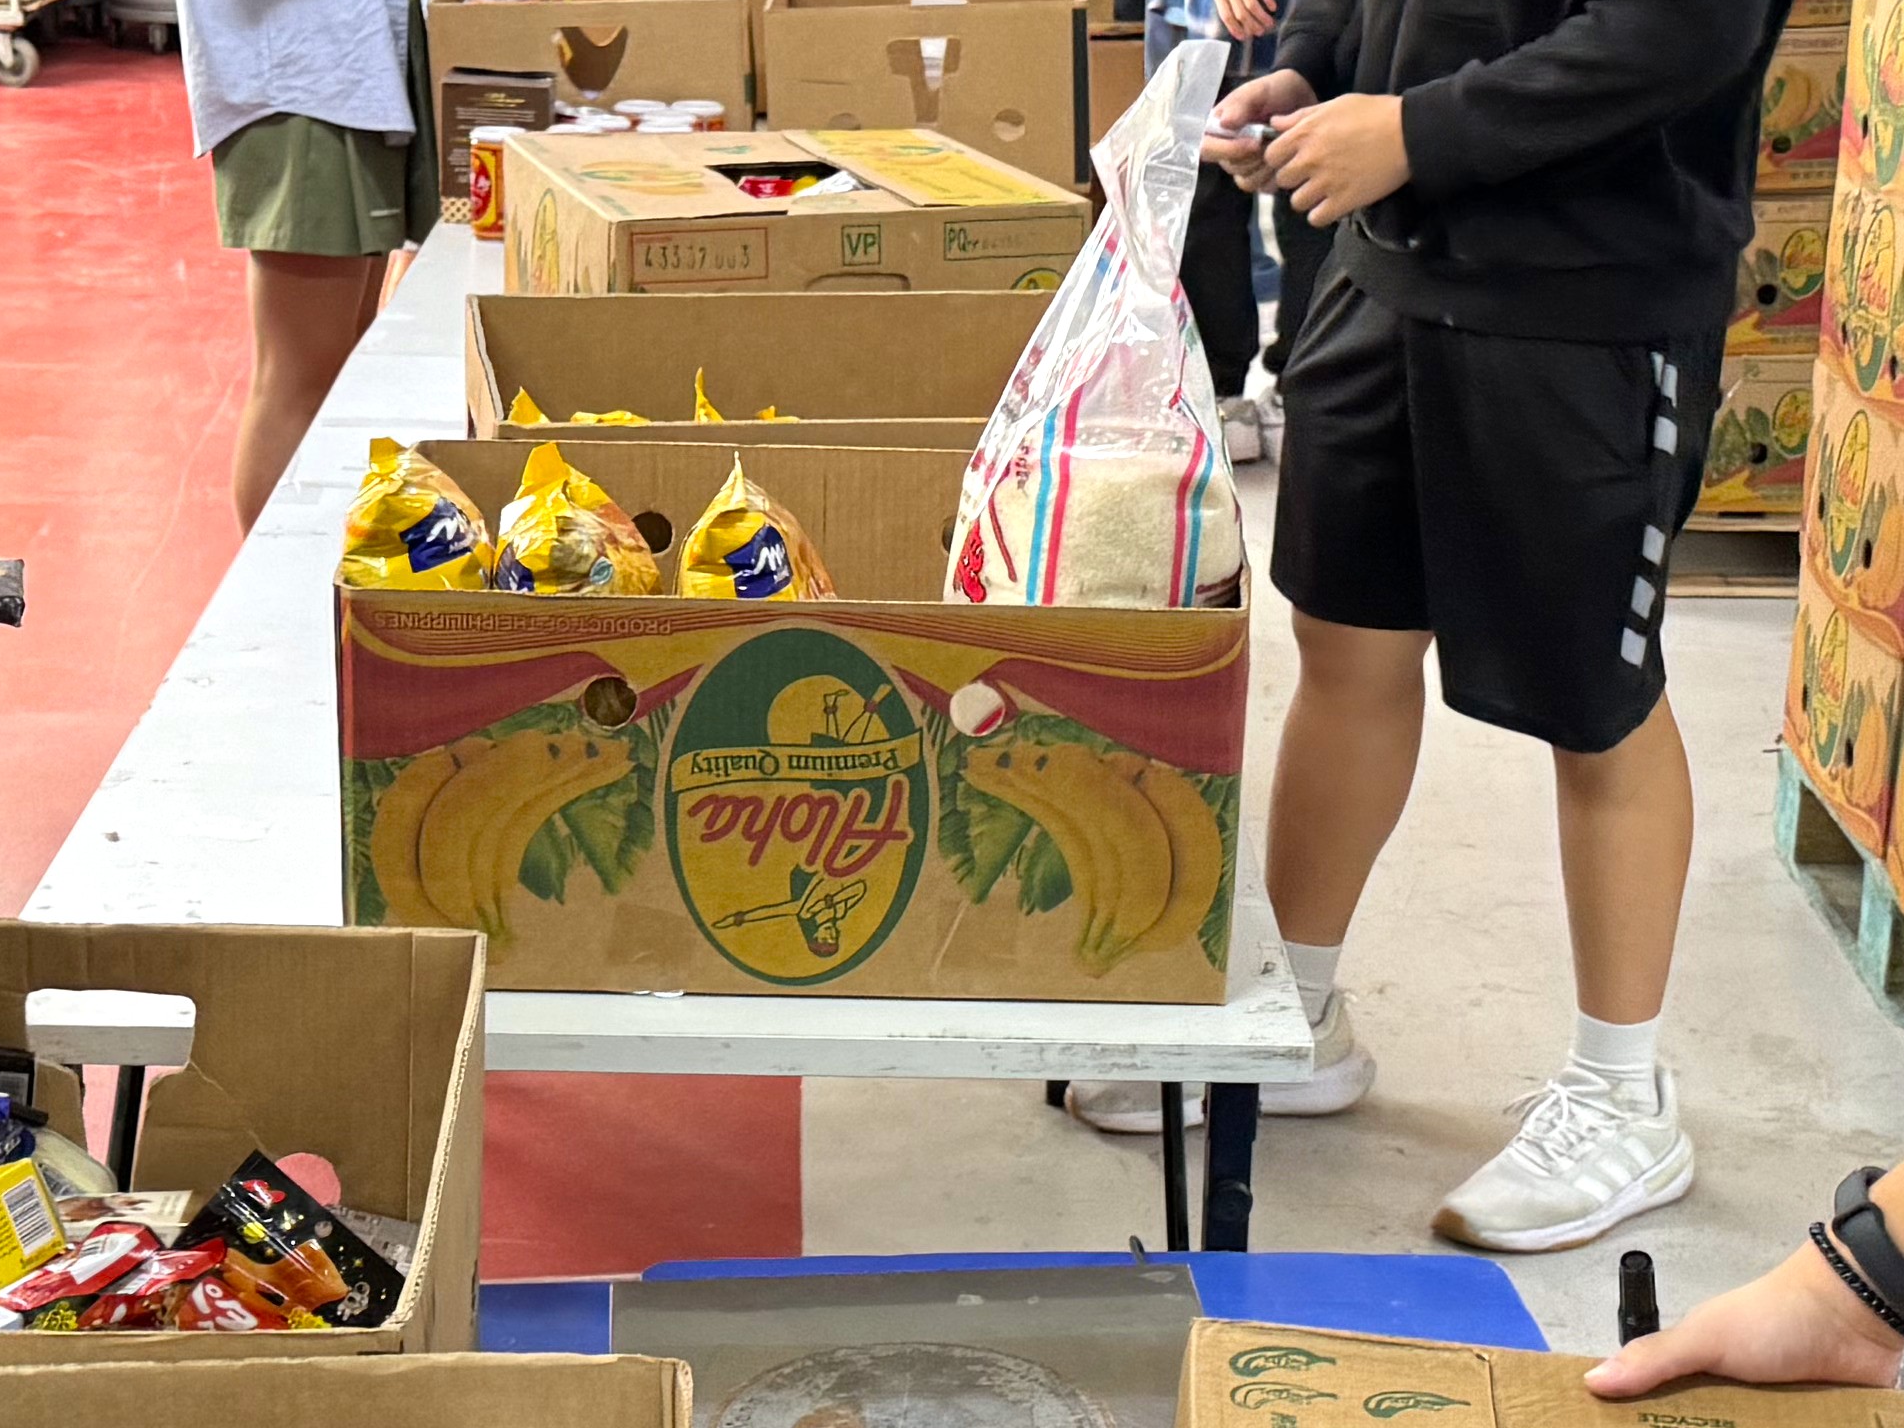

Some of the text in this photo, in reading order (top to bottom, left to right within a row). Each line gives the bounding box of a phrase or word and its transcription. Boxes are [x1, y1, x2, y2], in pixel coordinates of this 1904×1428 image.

[846, 233, 878, 258] VP
[688, 747, 899, 779] Premium Quality
[697, 779, 914, 880] Aloha
